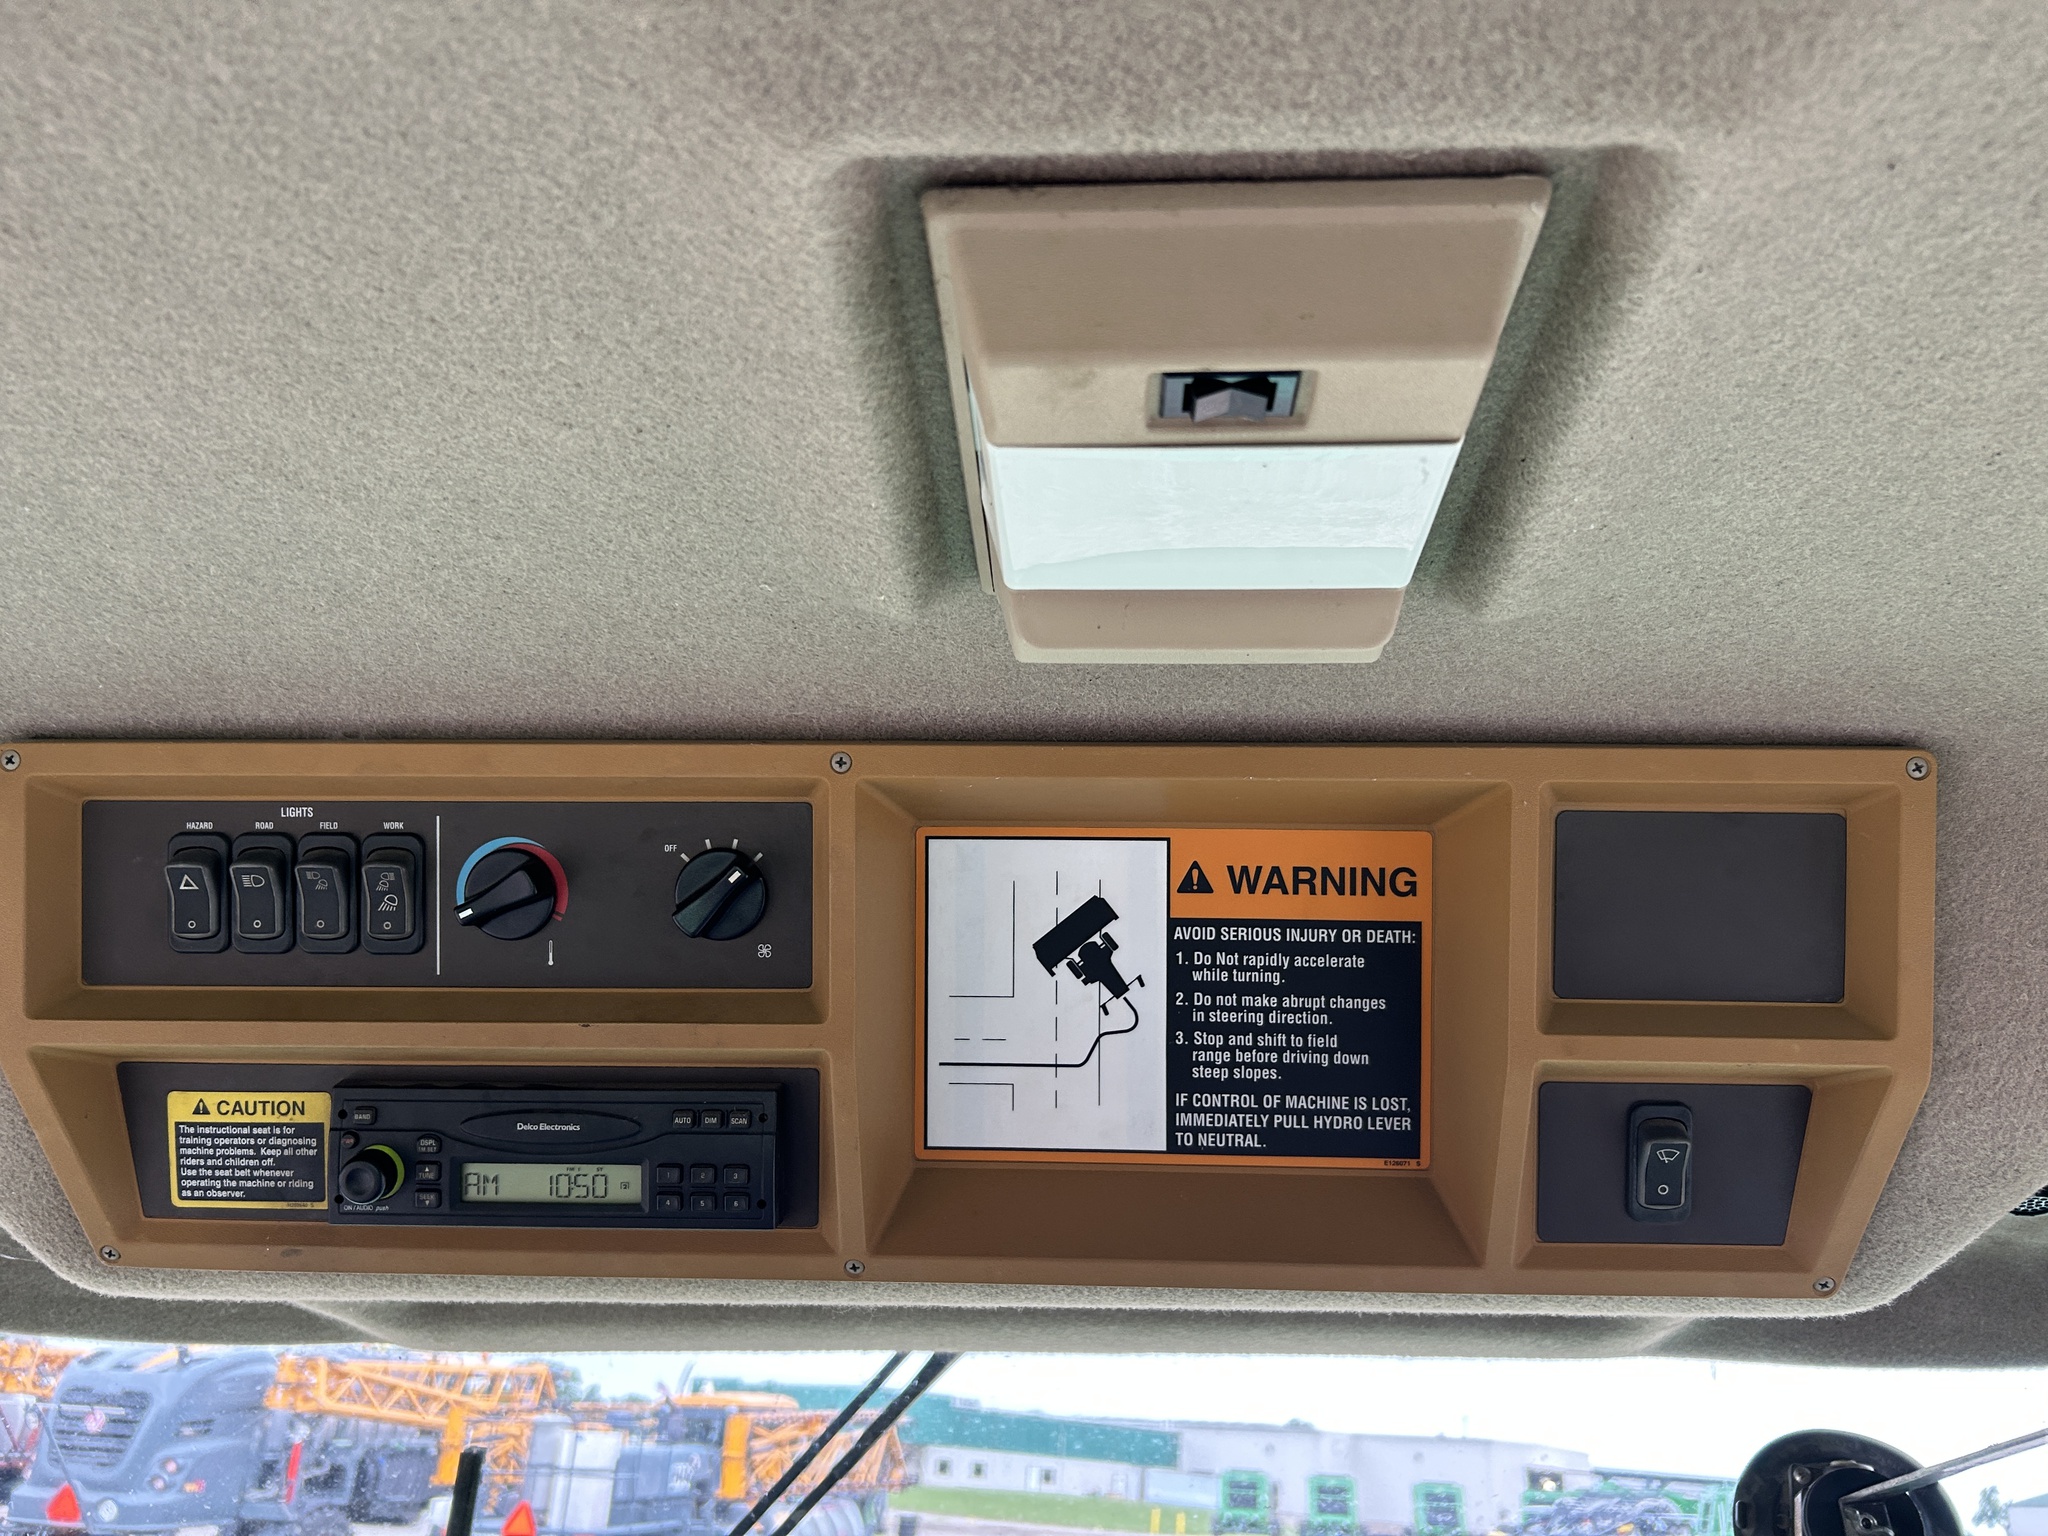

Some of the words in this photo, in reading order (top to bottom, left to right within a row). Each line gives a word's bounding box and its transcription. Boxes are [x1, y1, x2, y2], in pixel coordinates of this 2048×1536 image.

[281, 807, 313, 817] LIGHTS
[1227, 866, 1417, 897] WARNING
[1174, 927, 1215, 940] AVOID
[1221, 927, 1281, 941] SERIOUS
[1287, 929, 1337, 942] INJURY
[1342, 929, 1361, 942] OR
[1367, 930, 1415, 943] DEATH:
[1176, 952, 1188, 964] 1.
[1195, 952, 1211, 965] Do
[1217, 952, 1238, 965] Not
[1244, 953, 1289, 971] rapidly
[1294, 954, 1364, 967] accelerate
[1193, 968, 1228, 981] while
[1233, 969, 1284, 985] turning.
[1176, 992, 1188, 1005] 2.
[1194, 993, 1211, 1005] Do
[1217, 994, 1236, 1006] not
[1242, 994, 1277, 1007] make
[1283, 995, 1325, 1010] abrupt
[1330, 996, 1385, 1012] changes
[1193, 1009, 1204, 1021] in
[1209, 1010, 1263, 1026] steering
[1269, 1010, 1332, 1024] direction.
[1176, 1031, 1188, 1044] 3.
[1194, 1031, 1223, 1048] Stop
[1229, 1033, 1252, 1045] and
[1258, 1033, 1286, 1046] shift
[1291, 1034, 1303, 1047] to
[1308, 1034, 1337, 1047] field
[1193, 1051, 1230, 1064] range
[1236, 1049, 1277, 1062] before
[1283, 1050, 1328, 1066] driving
[1334, 1051, 1368, 1064] down
[1192, 1065, 1228, 1081] steep
[1234, 1066, 1281, 1081] slopes.
[217, 1100, 305, 1116] CAUTION
[1176, 1093, 1188, 1106] IF
[1193, 1094, 1258, 1107] CONTROL
[1264, 1095, 1280, 1108] OF
[1286, 1095, 1349, 1109] MACHINE
[1354, 1097, 1367, 1110] IS
[179, 1125, 194, 1133] The
[197, 1126, 250, 1134] instructional
[273, 1126, 280, 1134] is
[283, 1126, 295, 1134] for
[540, 1123, 580, 1131] Electronics
[1176, 1113, 1269, 1127] IMMEDIATELY
[1274, 1115, 1308, 1128] PULL
[1314, 1116, 1362, 1129] HYDRO
[1368, 1117, 1410, 1130] LEVER
[179, 1136, 211, 1146] training
[214, 1137, 255, 1146] operators
[269, 1137, 316, 1147] diagnosing
[1175, 1133, 1193, 1146] TO
[1198, 1133, 1266, 1147] NEUTRAL.
[180, 1147, 214, 1155] machine
[216, 1147, 256, 1156] problems.
[261, 1147, 281, 1157] Keep
[180, 1157, 204, 1165] riders
[225, 1158, 259, 1166] children
[262, 1158, 274, 1166] off.
[199, 1168, 212, 1176] the
[235, 1168, 250, 1176] belt
[181, 1179, 221, 1188] operating
[239, 1179, 275, 1187] machine
[289, 1180, 313, 1189] riding
[464, 1172, 498, 1196] AM
[549, 1174, 607, 1198] 10:50
[207, 1189, 245, 1197] observer.
